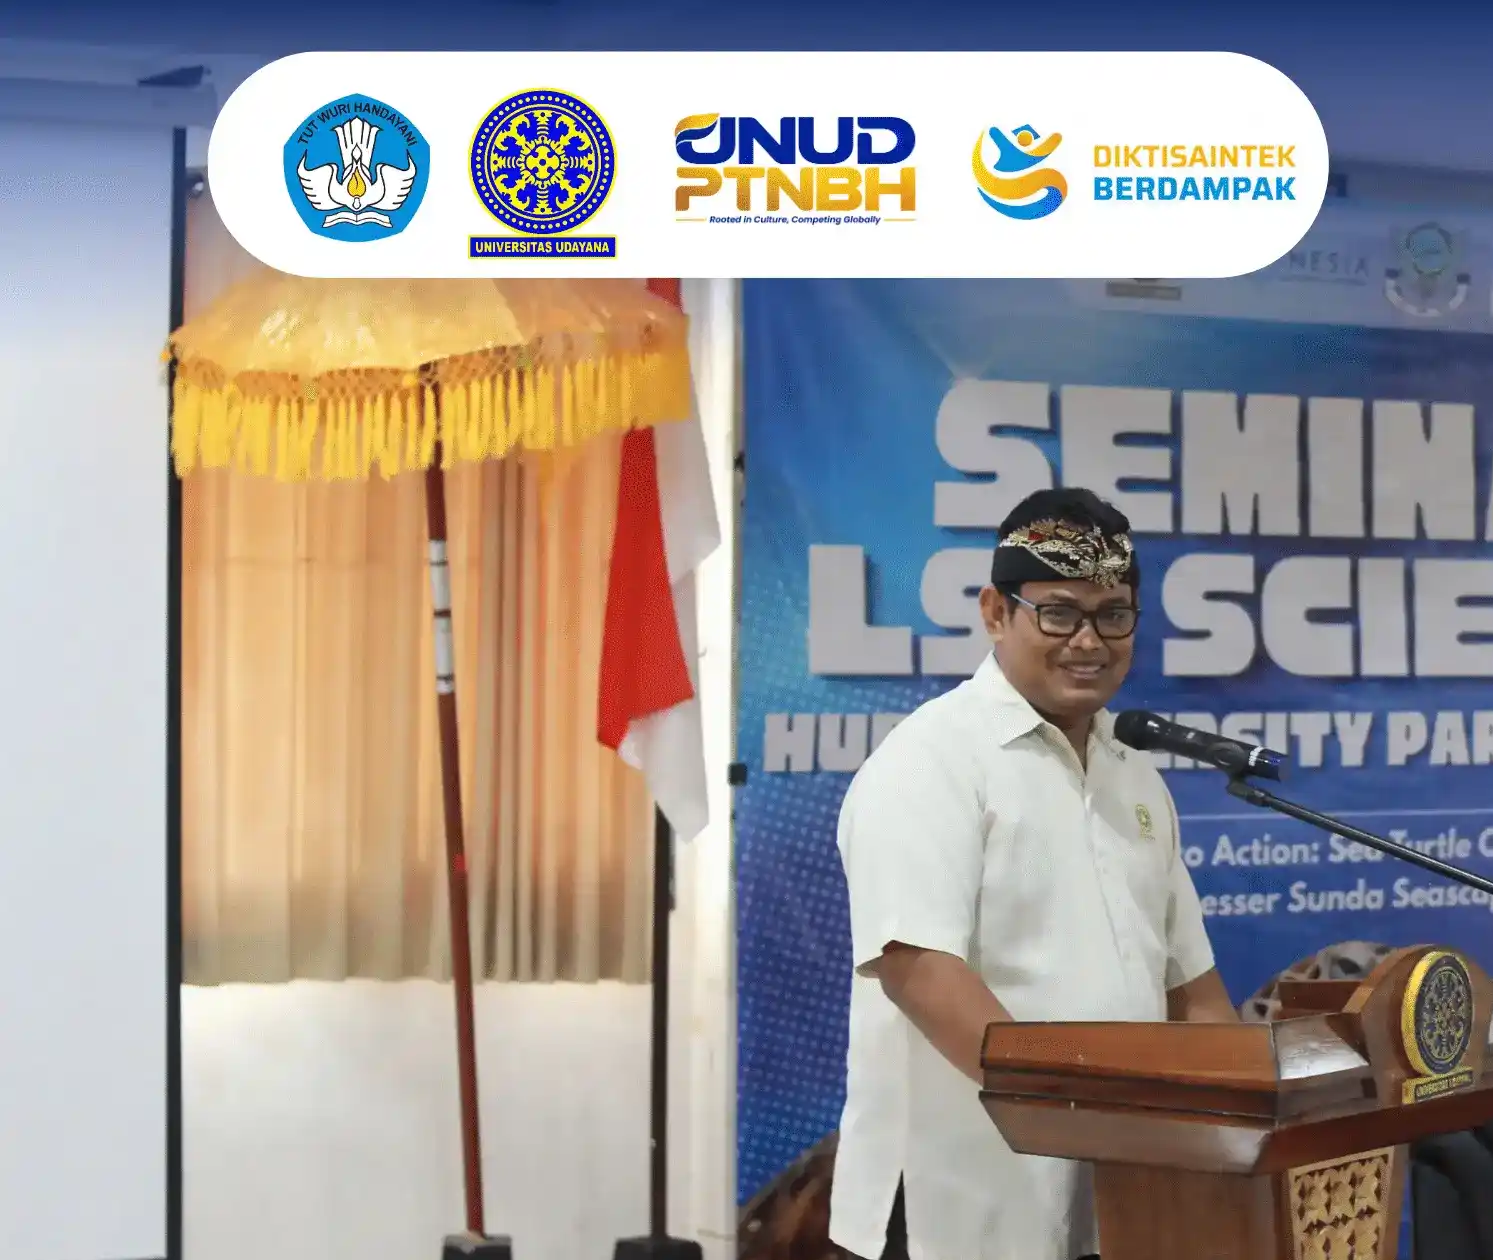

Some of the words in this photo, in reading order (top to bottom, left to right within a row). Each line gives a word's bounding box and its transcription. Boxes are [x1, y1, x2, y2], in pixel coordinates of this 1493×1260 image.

[1212, 833, 1320, 867] Action:
[1203, 893, 1275, 918] esser
[1288, 885, 1382, 915] Sunda
